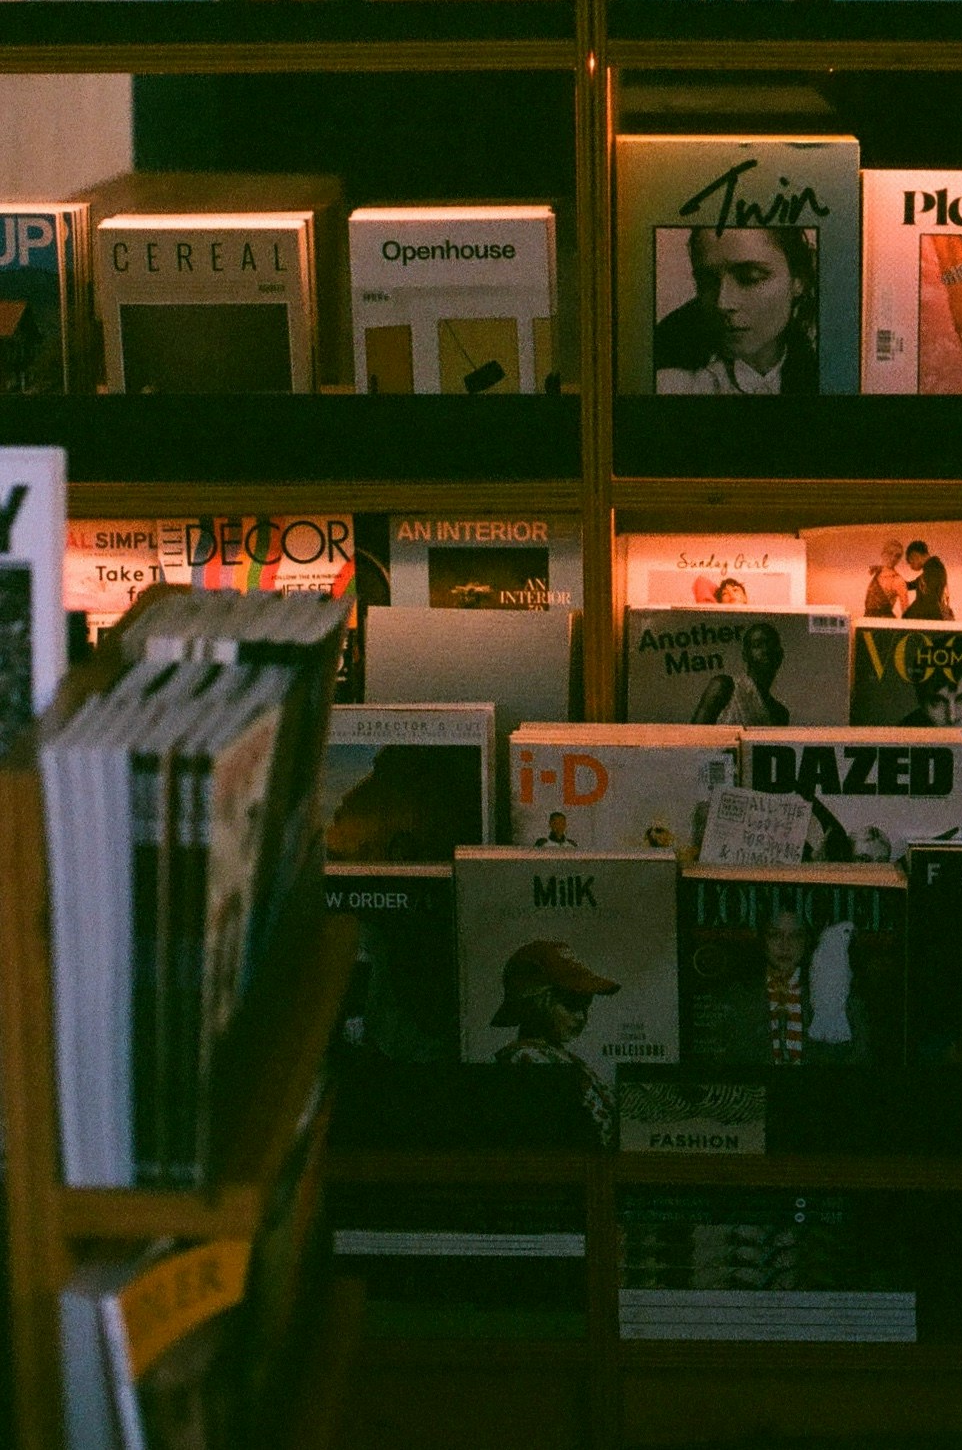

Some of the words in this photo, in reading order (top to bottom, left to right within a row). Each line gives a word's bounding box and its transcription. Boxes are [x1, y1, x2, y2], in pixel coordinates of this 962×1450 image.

[679, 158, 830, 237] Twin
[112, 242, 288, 273] CEREAL
[382, 239, 517, 266] Openhouse
[95, 532, 158, 549] SIMPL
[185, 520, 351, 566] DECOR
[397, 521, 431, 541] AN
[437, 521, 548, 542] INTERIOR
[95, 564, 144, 582] Take
[676, 553, 728, 576] Sunday
[524, 578, 547, 591] AN
[500, 590, 571, 605] INTERIOR
[639, 622, 744, 654] Another
[664, 650, 724, 676] Man
[520, 751, 609, 806] i-D
[752, 745, 954, 795] DAZED
[348, 891, 409, 909] ORDER
[650, 1133, 739, 1149] FASHION
